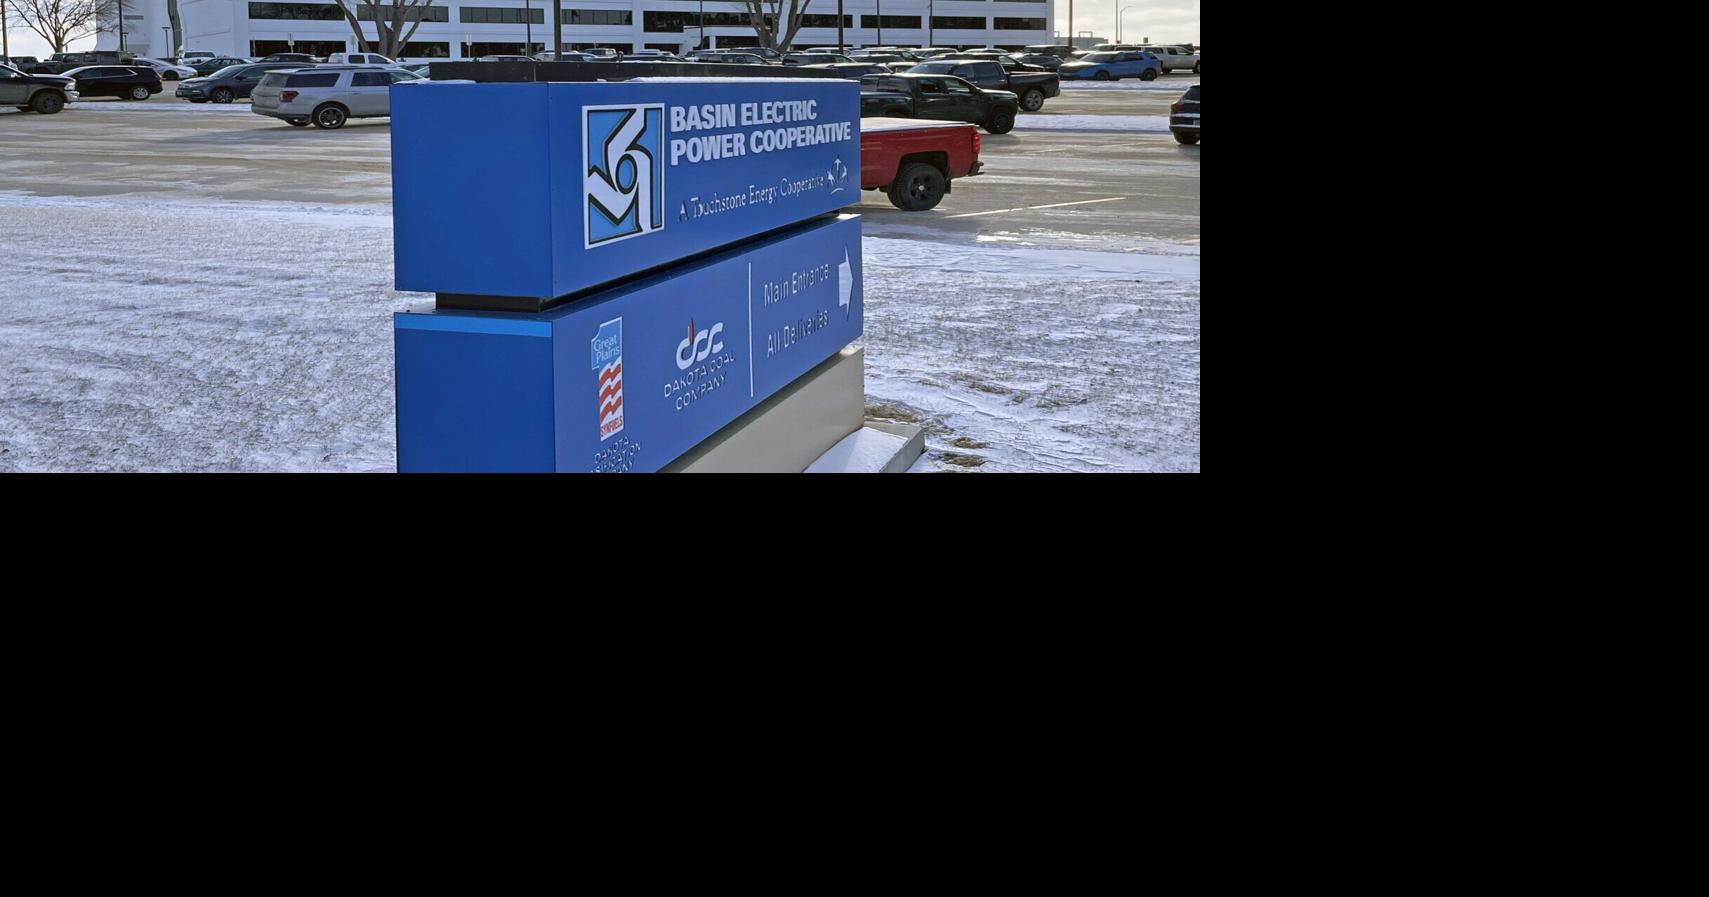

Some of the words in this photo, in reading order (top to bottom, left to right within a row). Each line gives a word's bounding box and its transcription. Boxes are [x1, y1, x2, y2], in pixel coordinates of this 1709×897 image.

[670, 104, 736, 132] BASIN
[741, 100, 817, 126] ELECTRIC
[671, 133, 746, 166] POWER
[750, 122, 851, 154] COOPERATIVE
[679, 201, 690, 222] A
[691, 194, 746, 218] Touchstone
[749, 185, 777, 204] Energy
[780, 177, 824, 197] Cooperative
[764, 281, 788, 307] Main
[792, 263, 828, 294] Entrance
[594, 335, 617, 352] Great
[597, 346, 620, 364] Plains
[767, 331, 780, 358] All
[784, 309, 828, 348] Deliveries
[664, 366, 708, 398] DAKOTA
[710, 353, 736, 373] COAL
[677, 373, 727, 410] COMPANY
